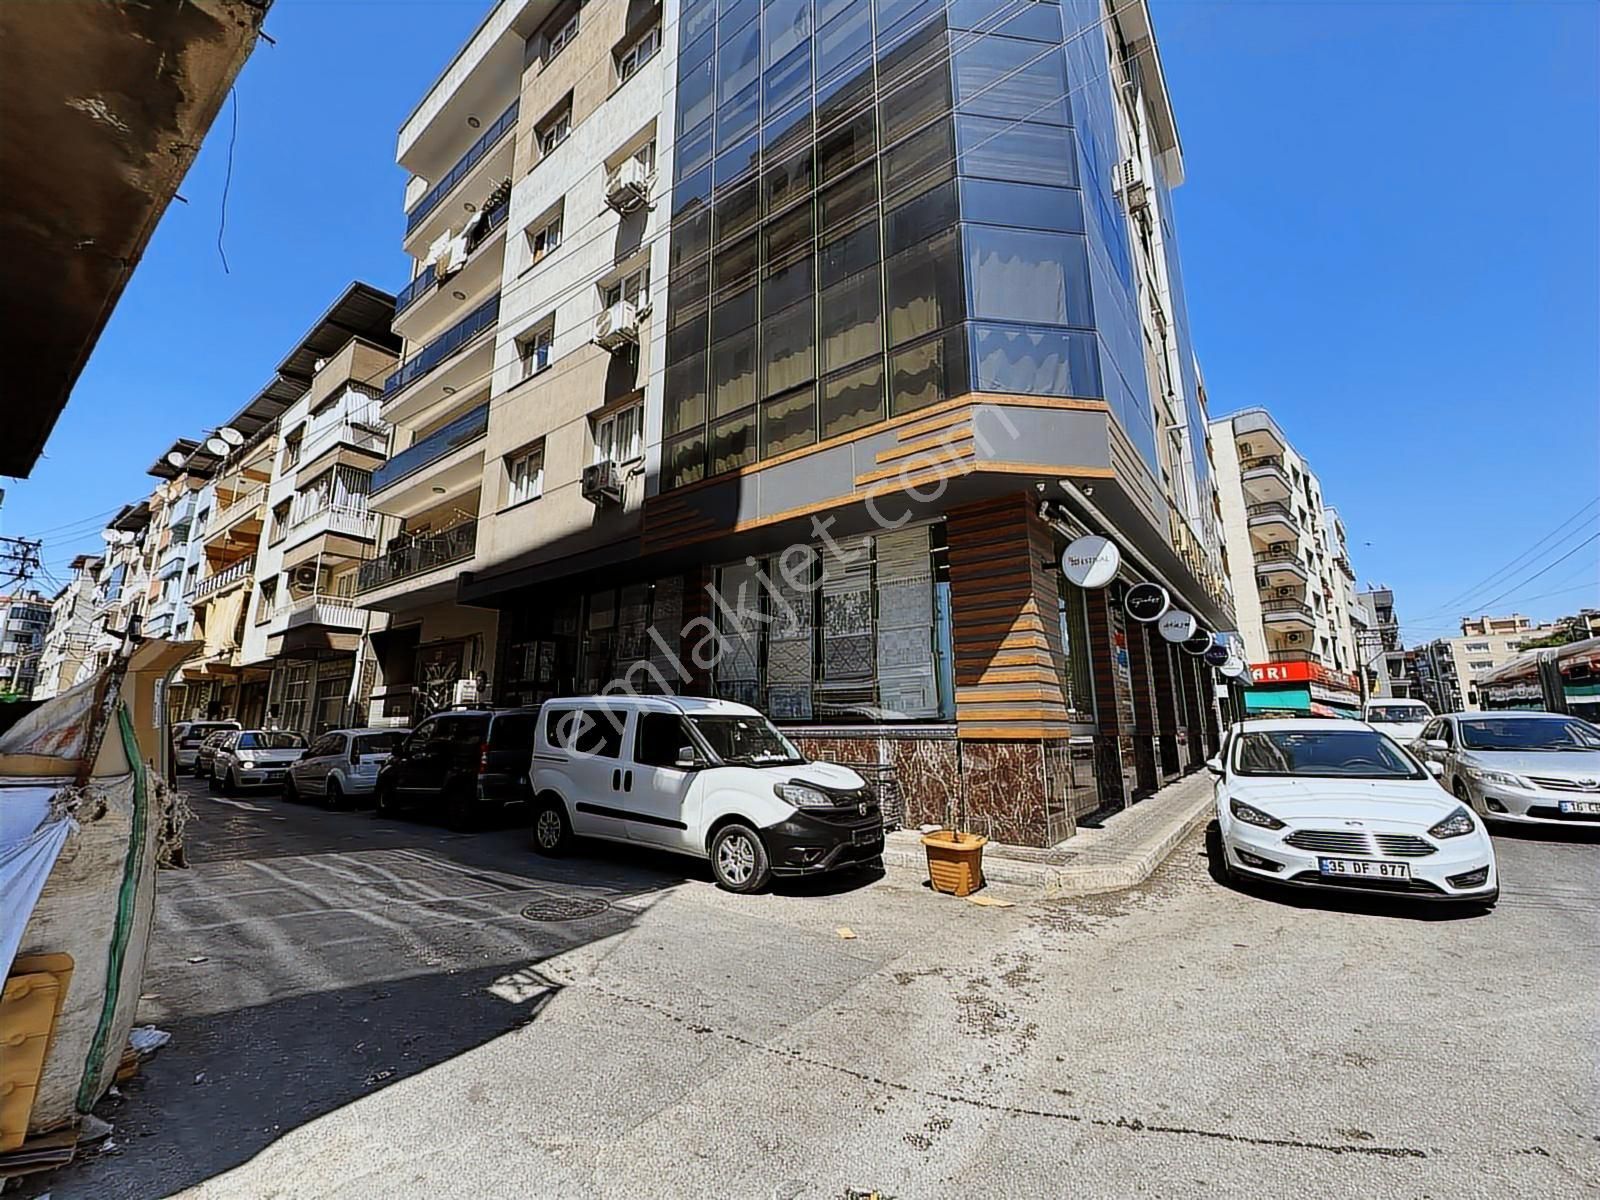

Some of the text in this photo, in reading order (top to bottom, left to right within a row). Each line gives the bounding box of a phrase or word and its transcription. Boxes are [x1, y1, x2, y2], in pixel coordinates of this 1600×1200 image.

[1329, 861, 1345, 872] 35
[1353, 862, 1370, 873] DF
[1380, 864, 1406, 876] 877
